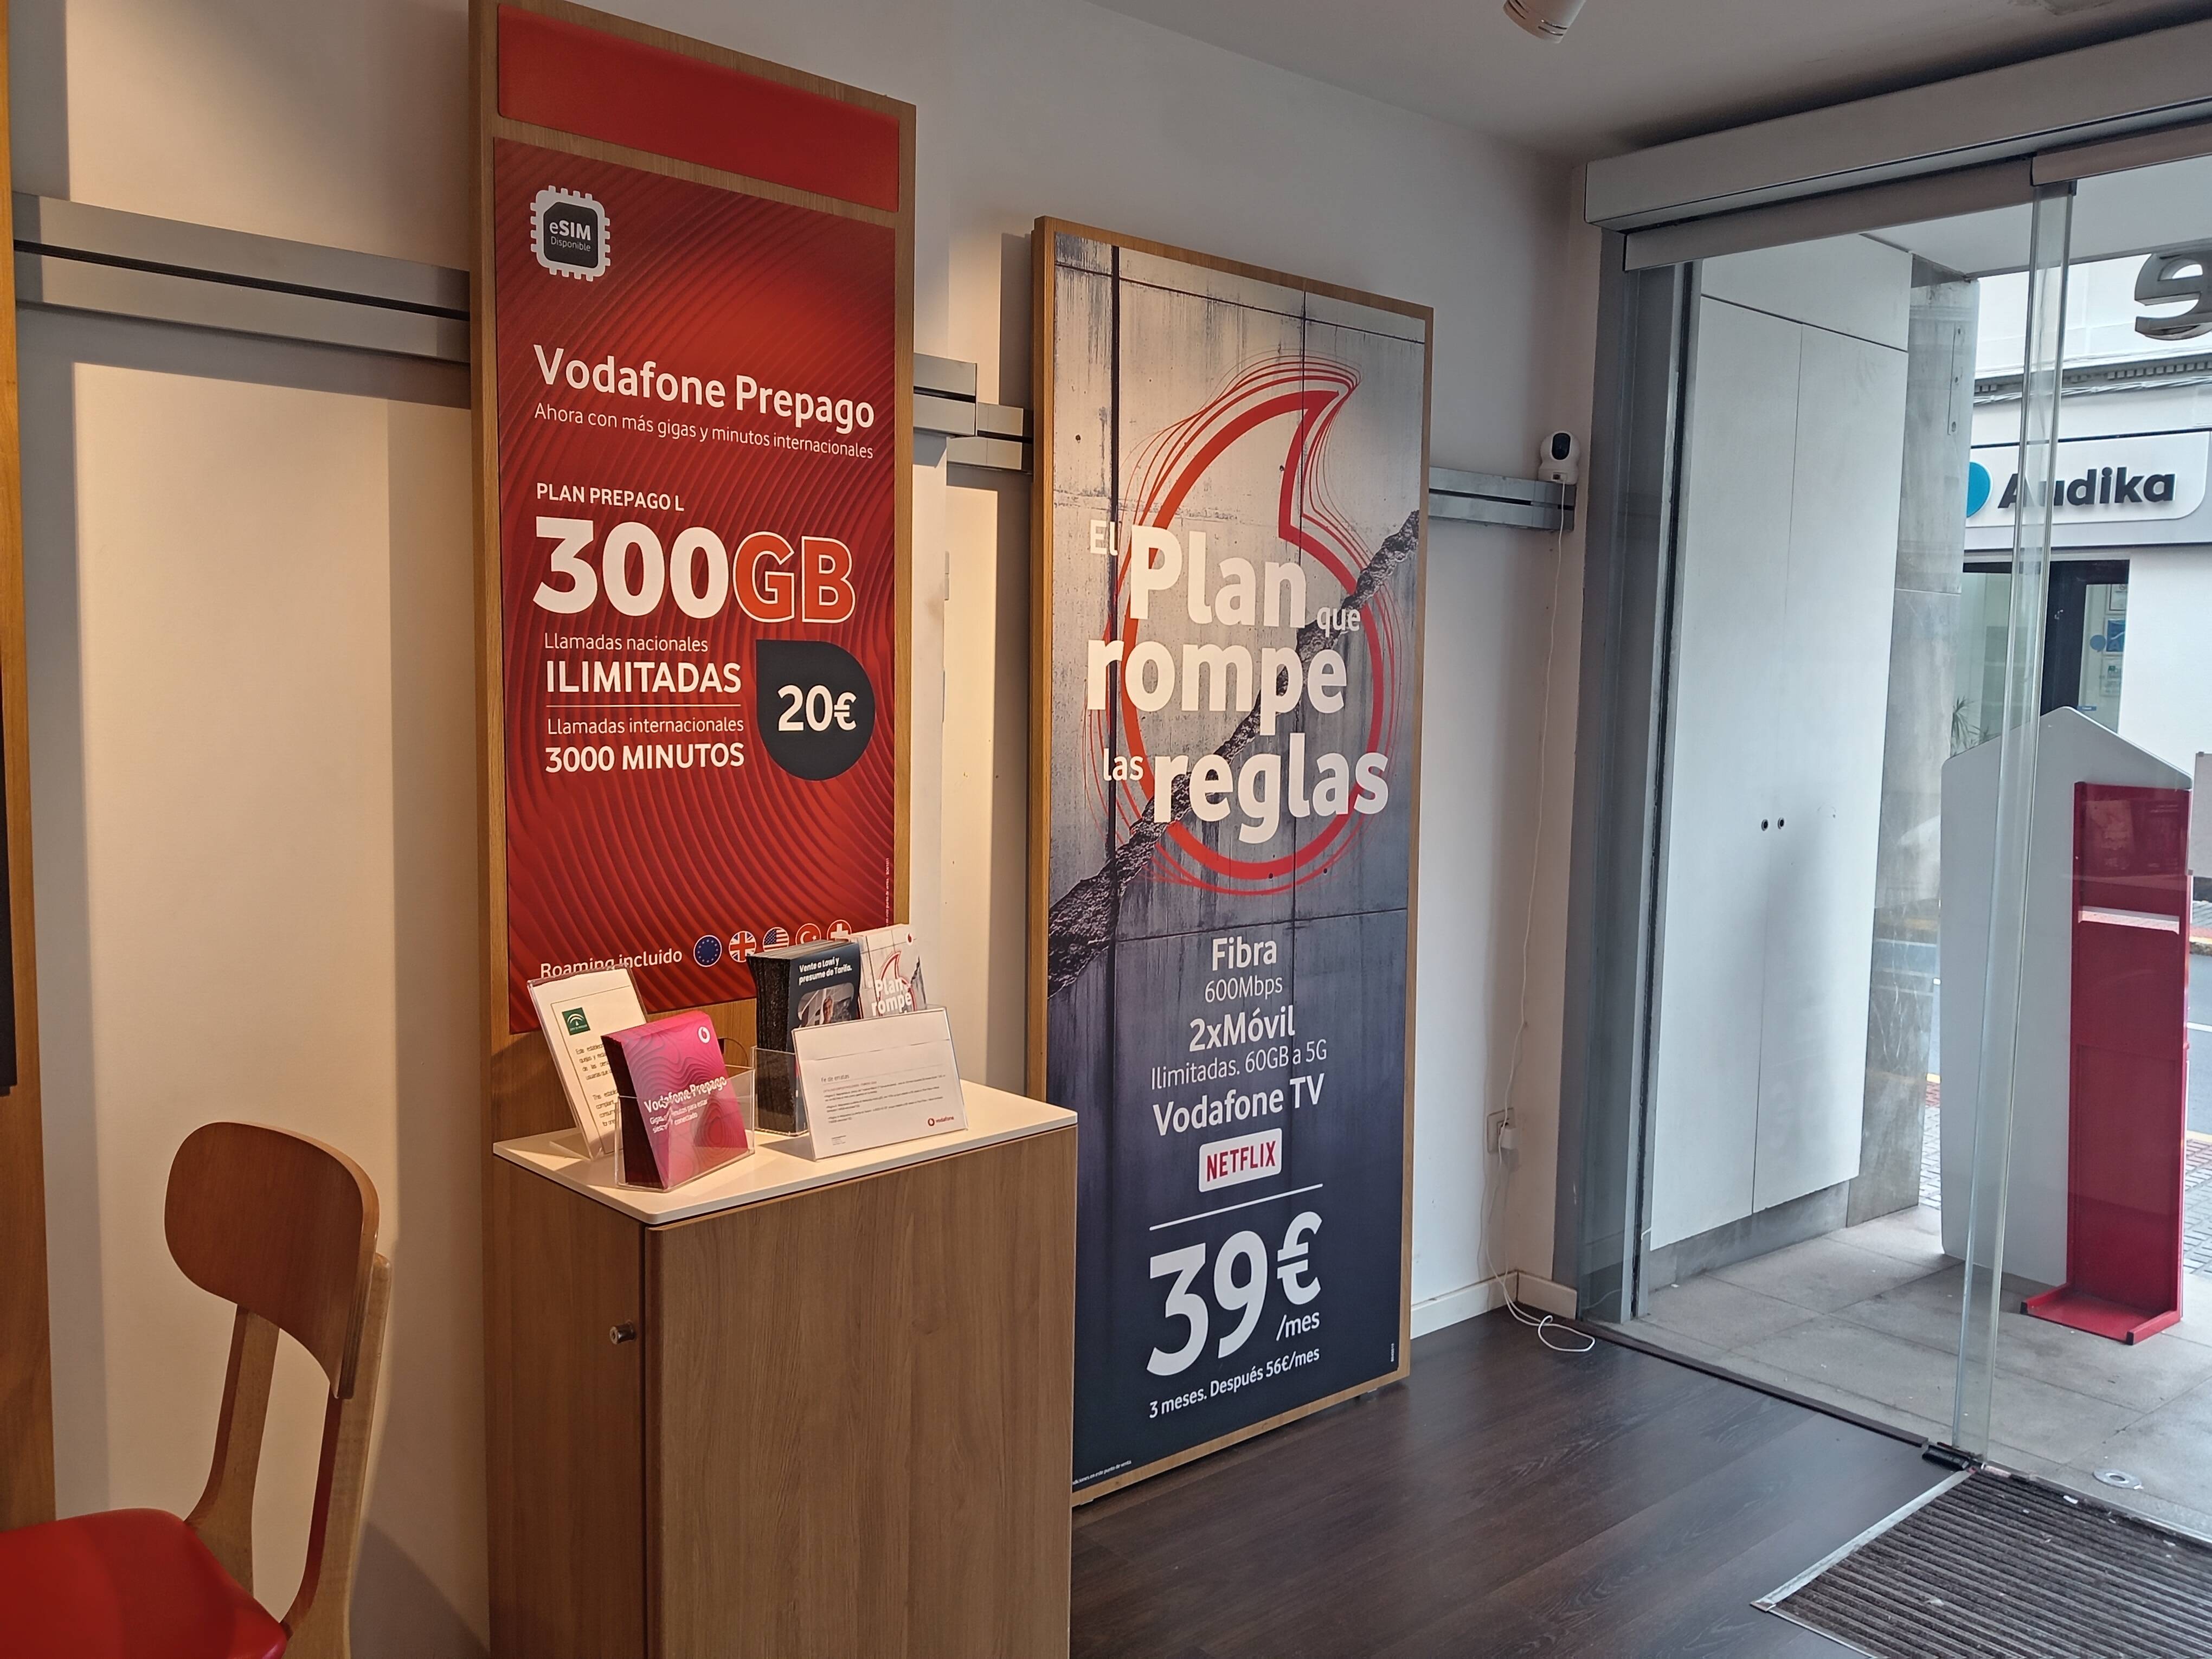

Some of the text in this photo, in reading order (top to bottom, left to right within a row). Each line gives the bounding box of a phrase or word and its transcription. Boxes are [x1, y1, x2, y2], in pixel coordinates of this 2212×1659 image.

[549, 218, 591, 241] eSIM
[550, 236, 591, 252] Disponible
[533, 344, 874, 434] Vodafone Prepago
[535, 402, 873, 459] Ahora con más gigas y minutos internacionales
[537, 483, 685, 512] PLAN PREPAGO L
[1998, 466, 2176, 509] Audika
[533, 516, 856, 623] 300GB
[1089, 519, 1361, 637] El Plan que
[544, 632, 709, 652] Llamadas nacionales
[546, 660, 742, 694] ILIMITADAS
[1086, 639, 1347, 736] rompe
[777, 684, 857, 731] 20€
[548, 717, 744, 735] Llamadas internacionales
[545, 742, 744, 773] 3000 MINUTOS
[1103, 732, 1388, 844] las reglas
[541, 948, 682, 978] Roaming incluido
[799, 963, 817, 973] Vente
[822, 957, 835, 967] Lowi
[835, 957, 840, 966] y
[1212, 936, 1277, 971] Fibra
[799, 971, 825, 986] presume
[874, 976, 904, 998] Plan
[1205, 976, 1283, 1003] 600Mbps
[871, 992, 912, 1016] rompe
[1189, 1005, 1295, 1052] 2xMóvil
[1152, 1039, 1327, 1090] Ilimitadas. 60GB a 5G
[644, 1076, 727, 1113] Vodafone Prepago
[1153, 1073, 1324, 1136] Vodafone TV
[1206, 1141, 1276, 1182] NETFLIX
[1146, 1211, 1322, 1376] 39€
[1276, 1311, 1320, 1341] /mes
[1149, 1347, 1320, 1419] 3 meses. Después 56€/mes
